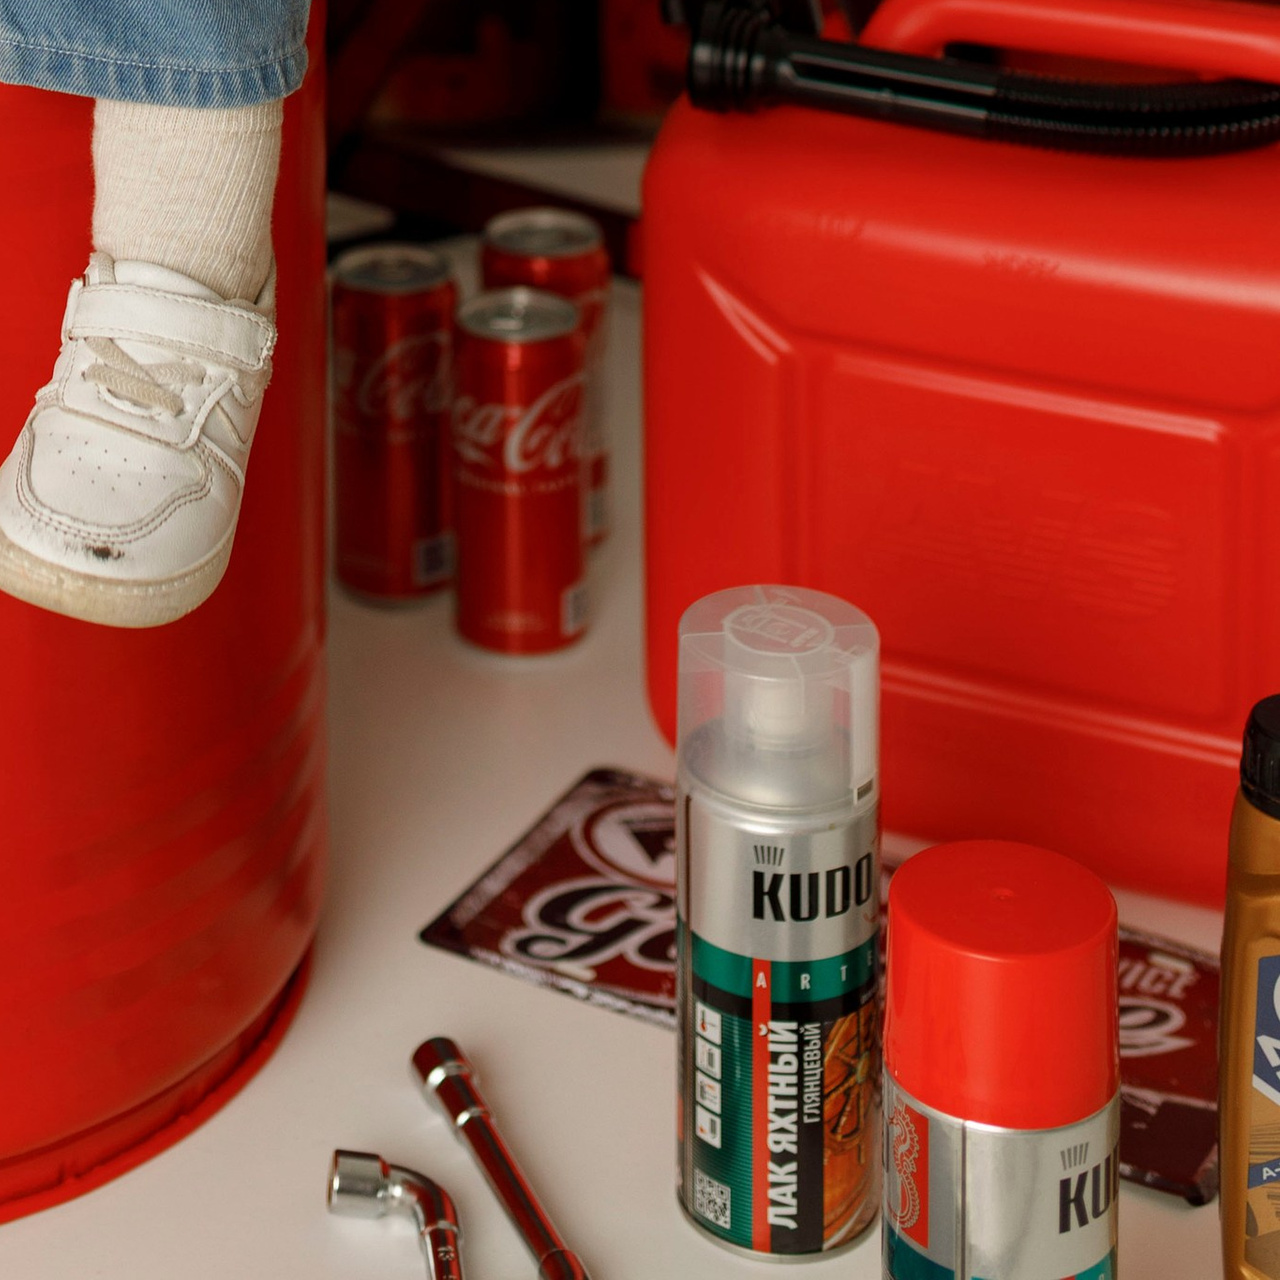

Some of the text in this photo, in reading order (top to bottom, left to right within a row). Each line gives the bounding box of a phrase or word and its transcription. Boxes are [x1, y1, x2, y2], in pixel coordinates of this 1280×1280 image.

[753, 852, 872, 922] KUDO
[800, 1022, 823, 1124] ГЛЯНЦЕВЫЙ
[758, 1020, 798, 1230] ЛАК ЯХТНЫЙ
